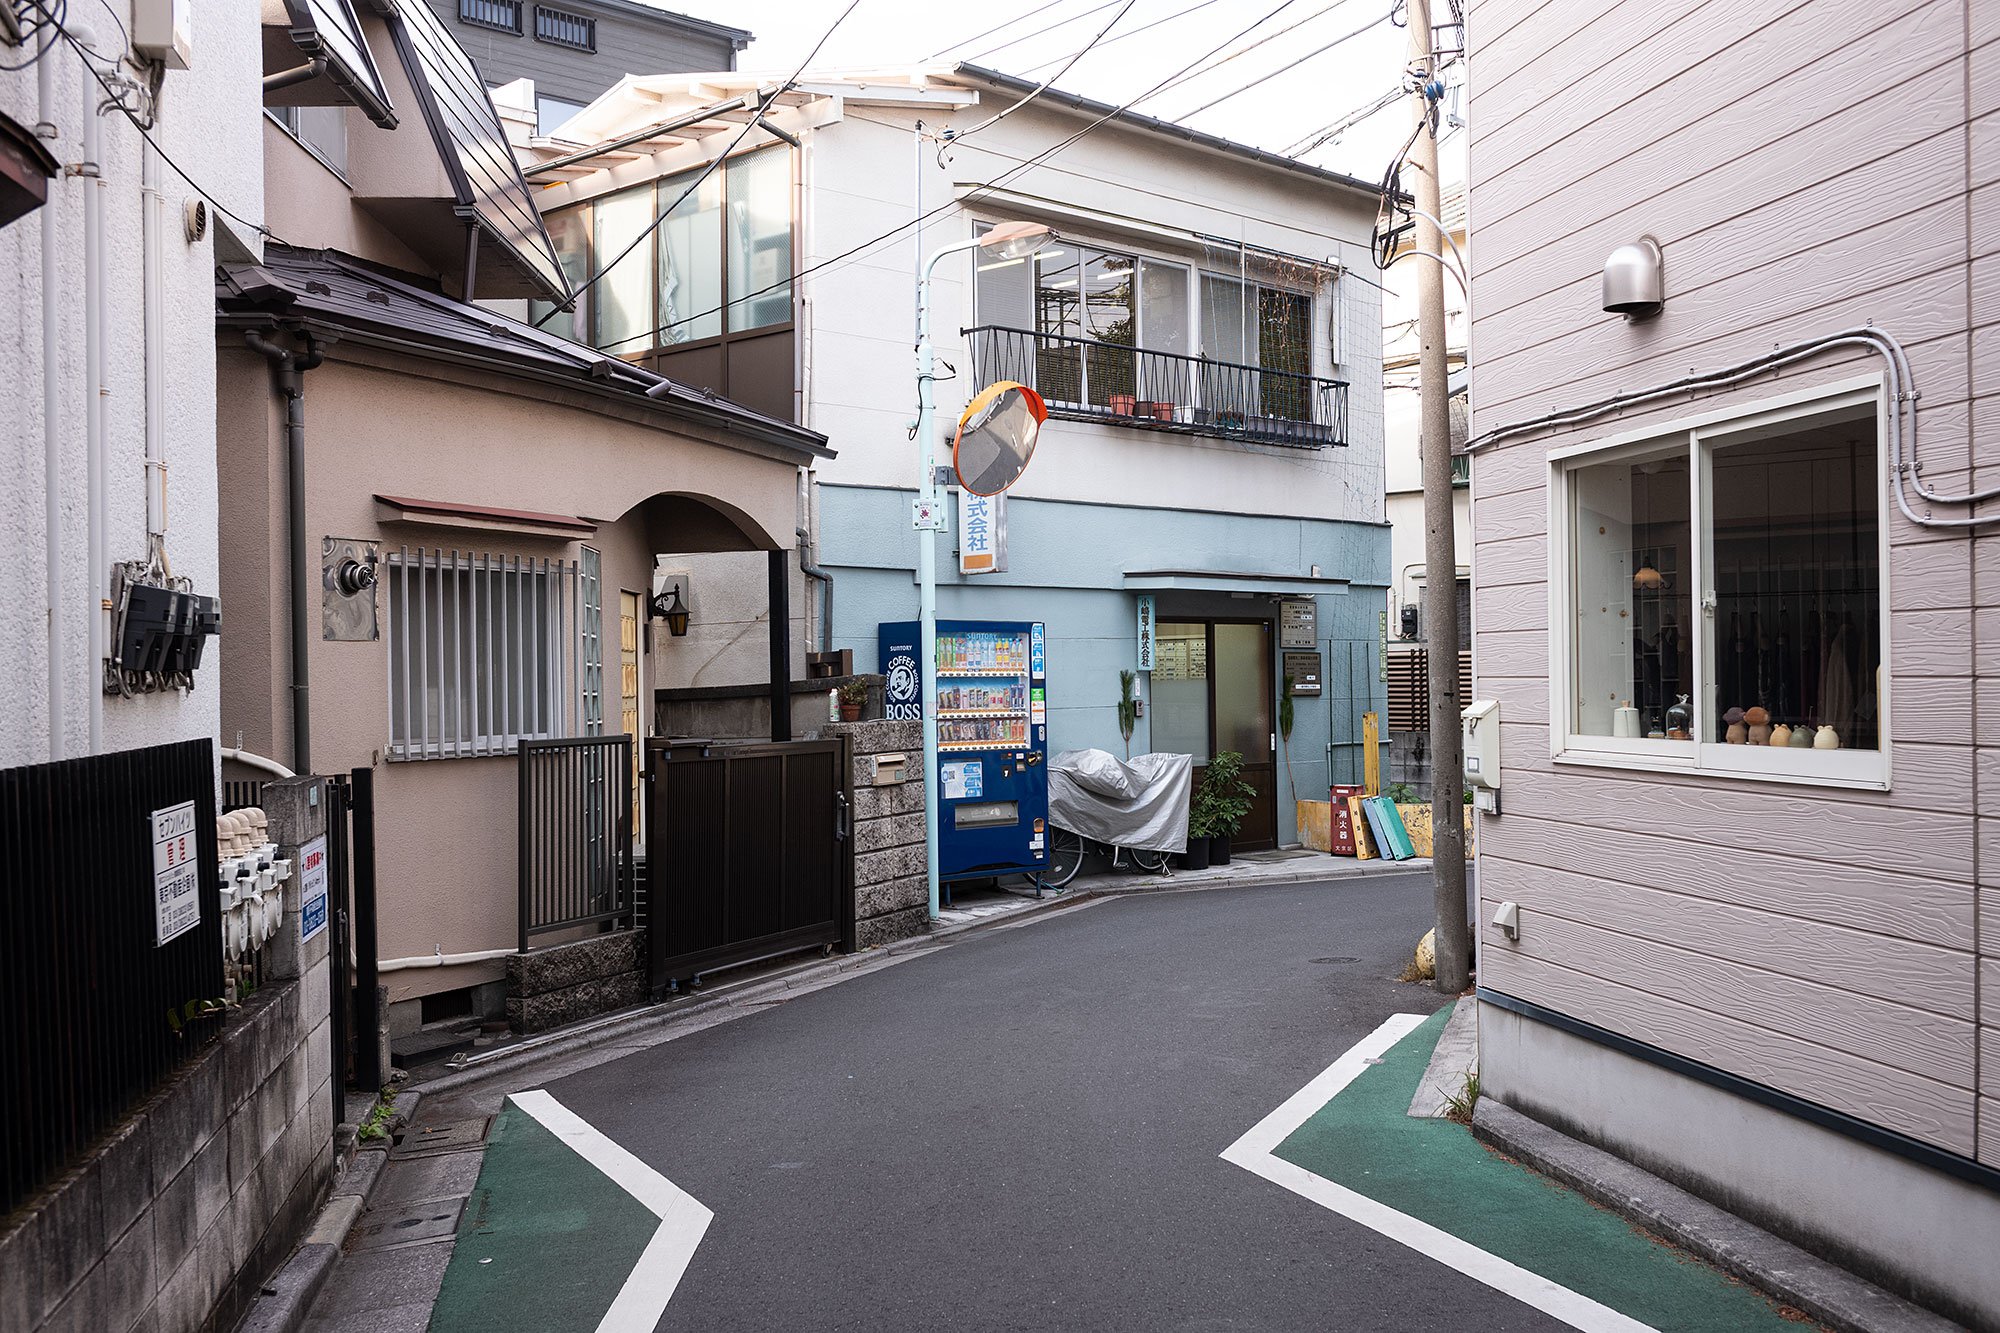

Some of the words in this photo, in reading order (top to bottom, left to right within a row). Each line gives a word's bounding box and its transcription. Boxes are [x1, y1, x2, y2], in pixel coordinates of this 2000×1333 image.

[888, 655, 916, 670] COFFEE
[885, 704, 921, 720] BOSS
[159, 811, 191, 838] セブンハイツ
[1339, 810, 1348, 840] 消火器
